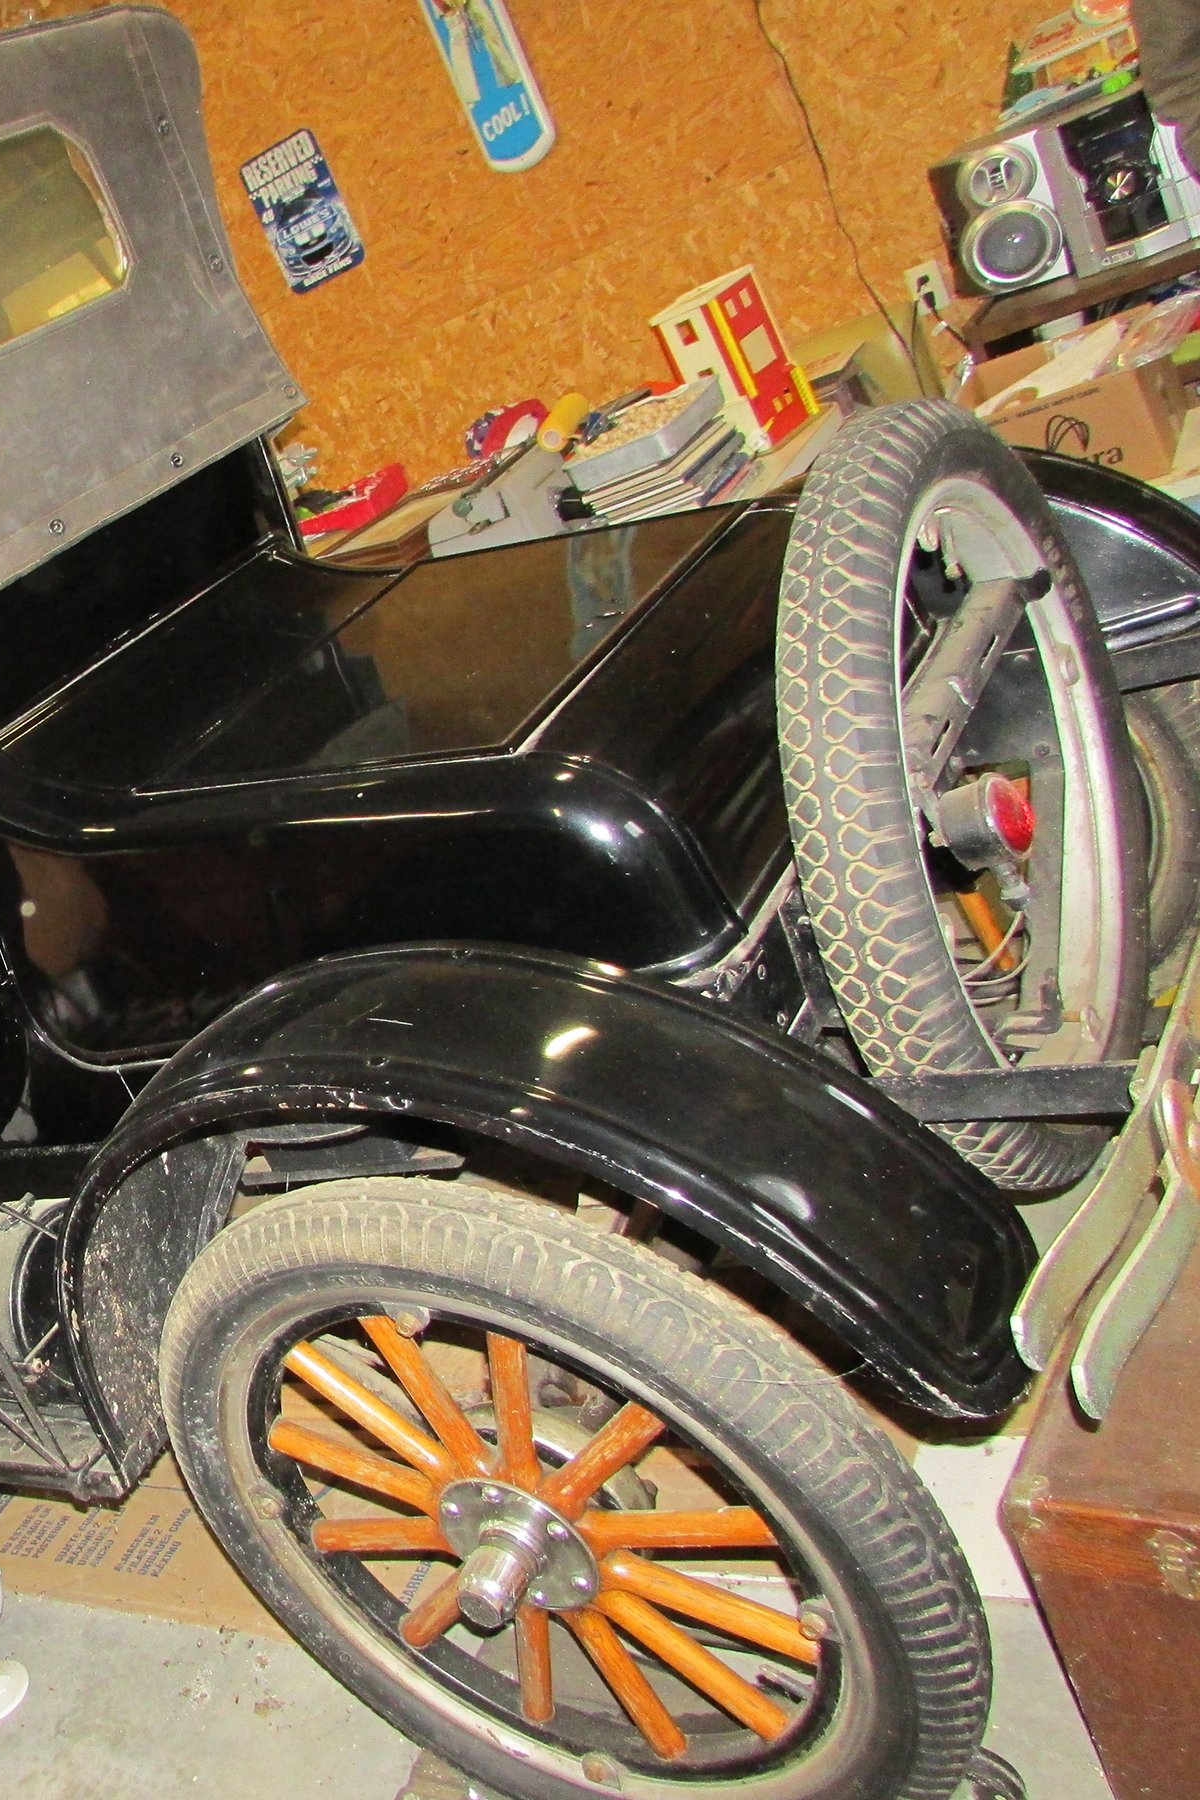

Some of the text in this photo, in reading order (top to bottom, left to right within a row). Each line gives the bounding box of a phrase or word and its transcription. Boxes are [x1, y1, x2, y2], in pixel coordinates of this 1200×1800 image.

[482, 93, 531, 142] COOL!
[241, 131, 315, 192] RESERVED
[259, 162, 318, 208] PARKING
